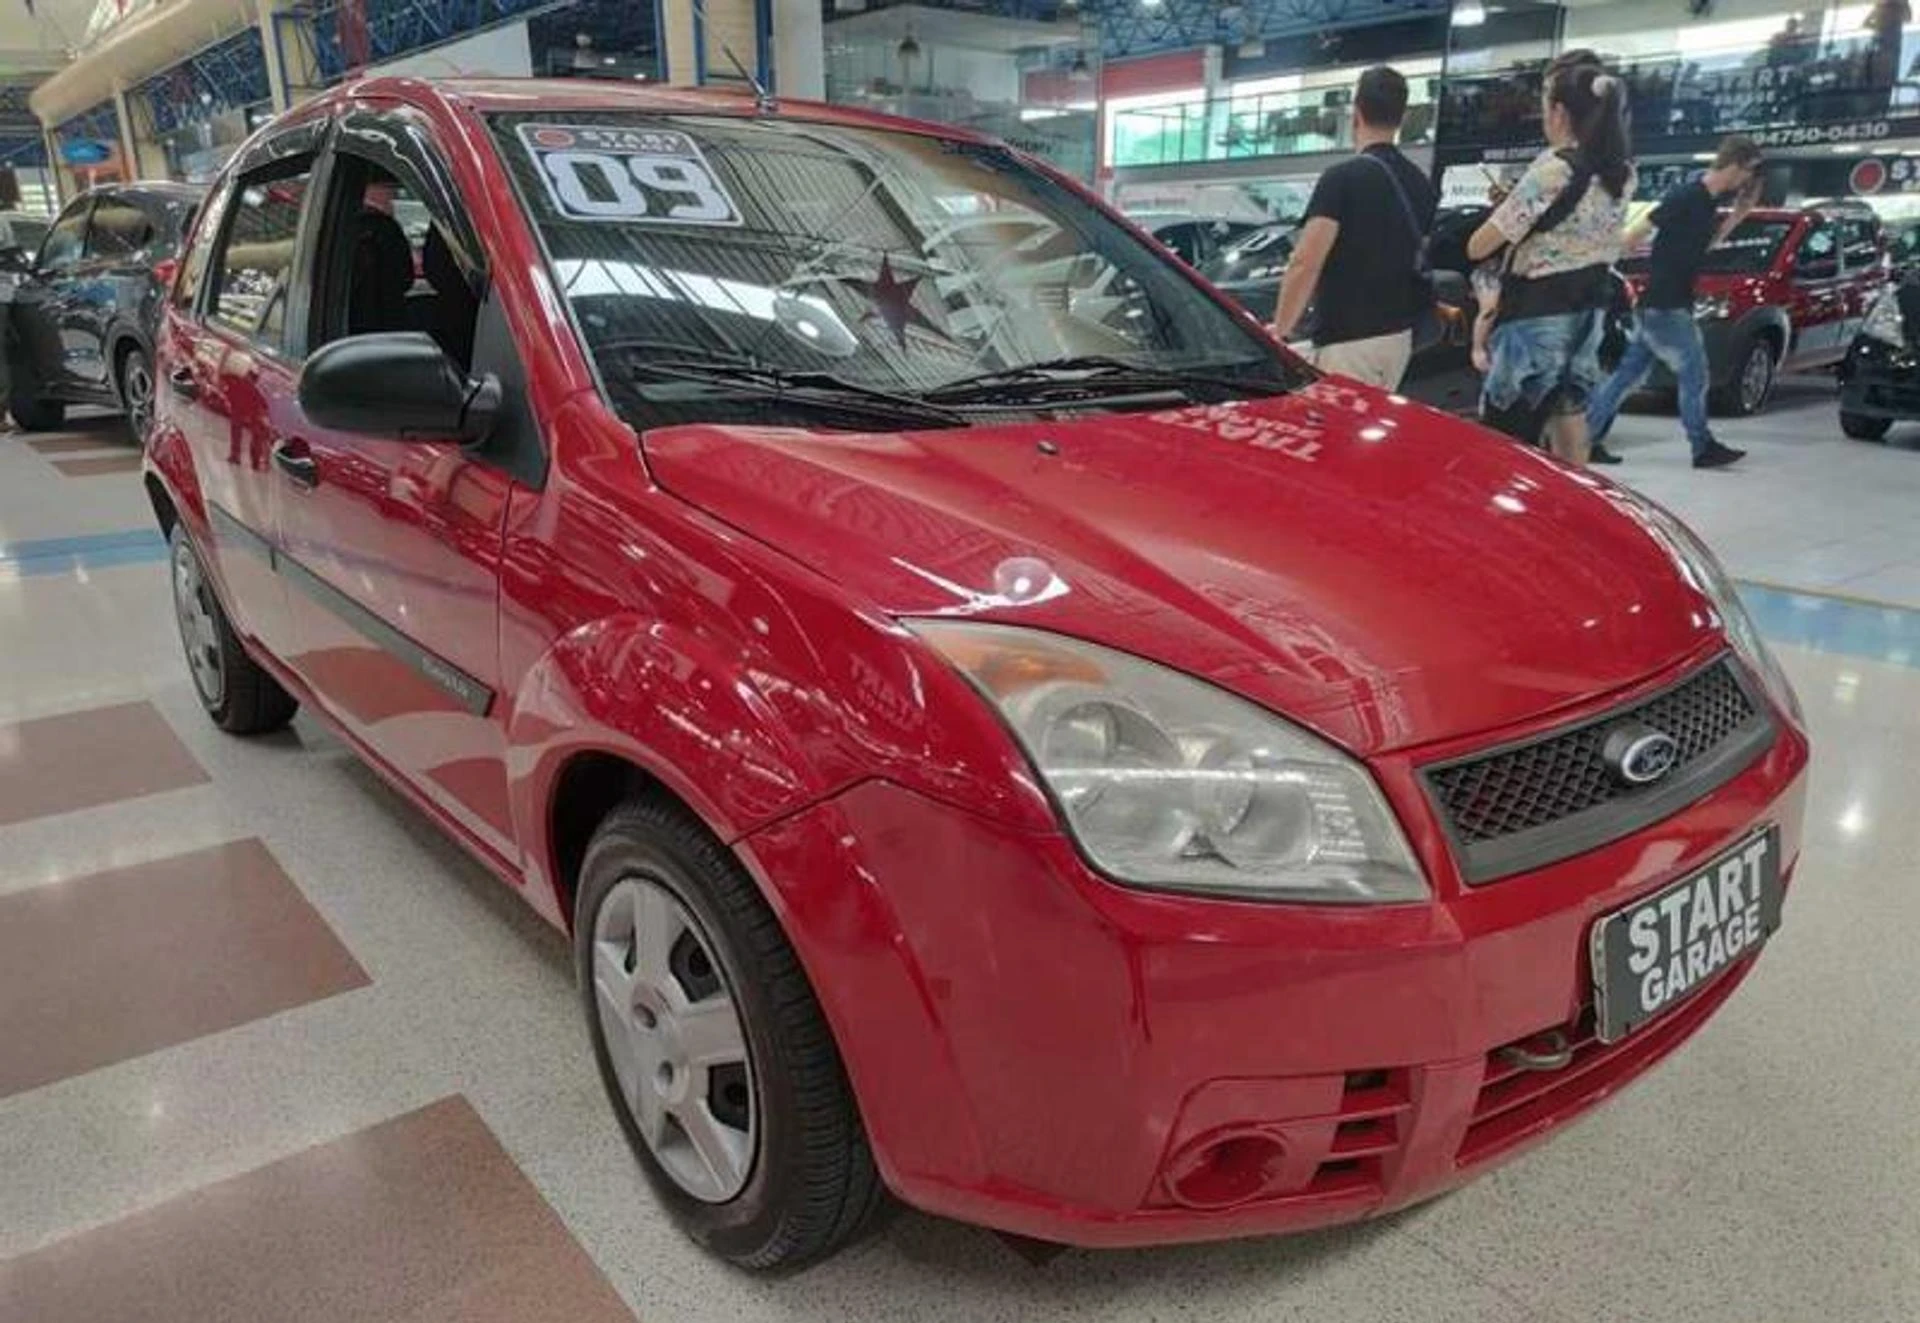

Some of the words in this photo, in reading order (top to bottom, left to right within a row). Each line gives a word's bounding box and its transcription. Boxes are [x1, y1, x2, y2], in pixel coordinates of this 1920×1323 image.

[544, 153, 730, 220] 09
[1628, 838, 1768, 974] START
[1640, 902, 1761, 1013] GARAGE
